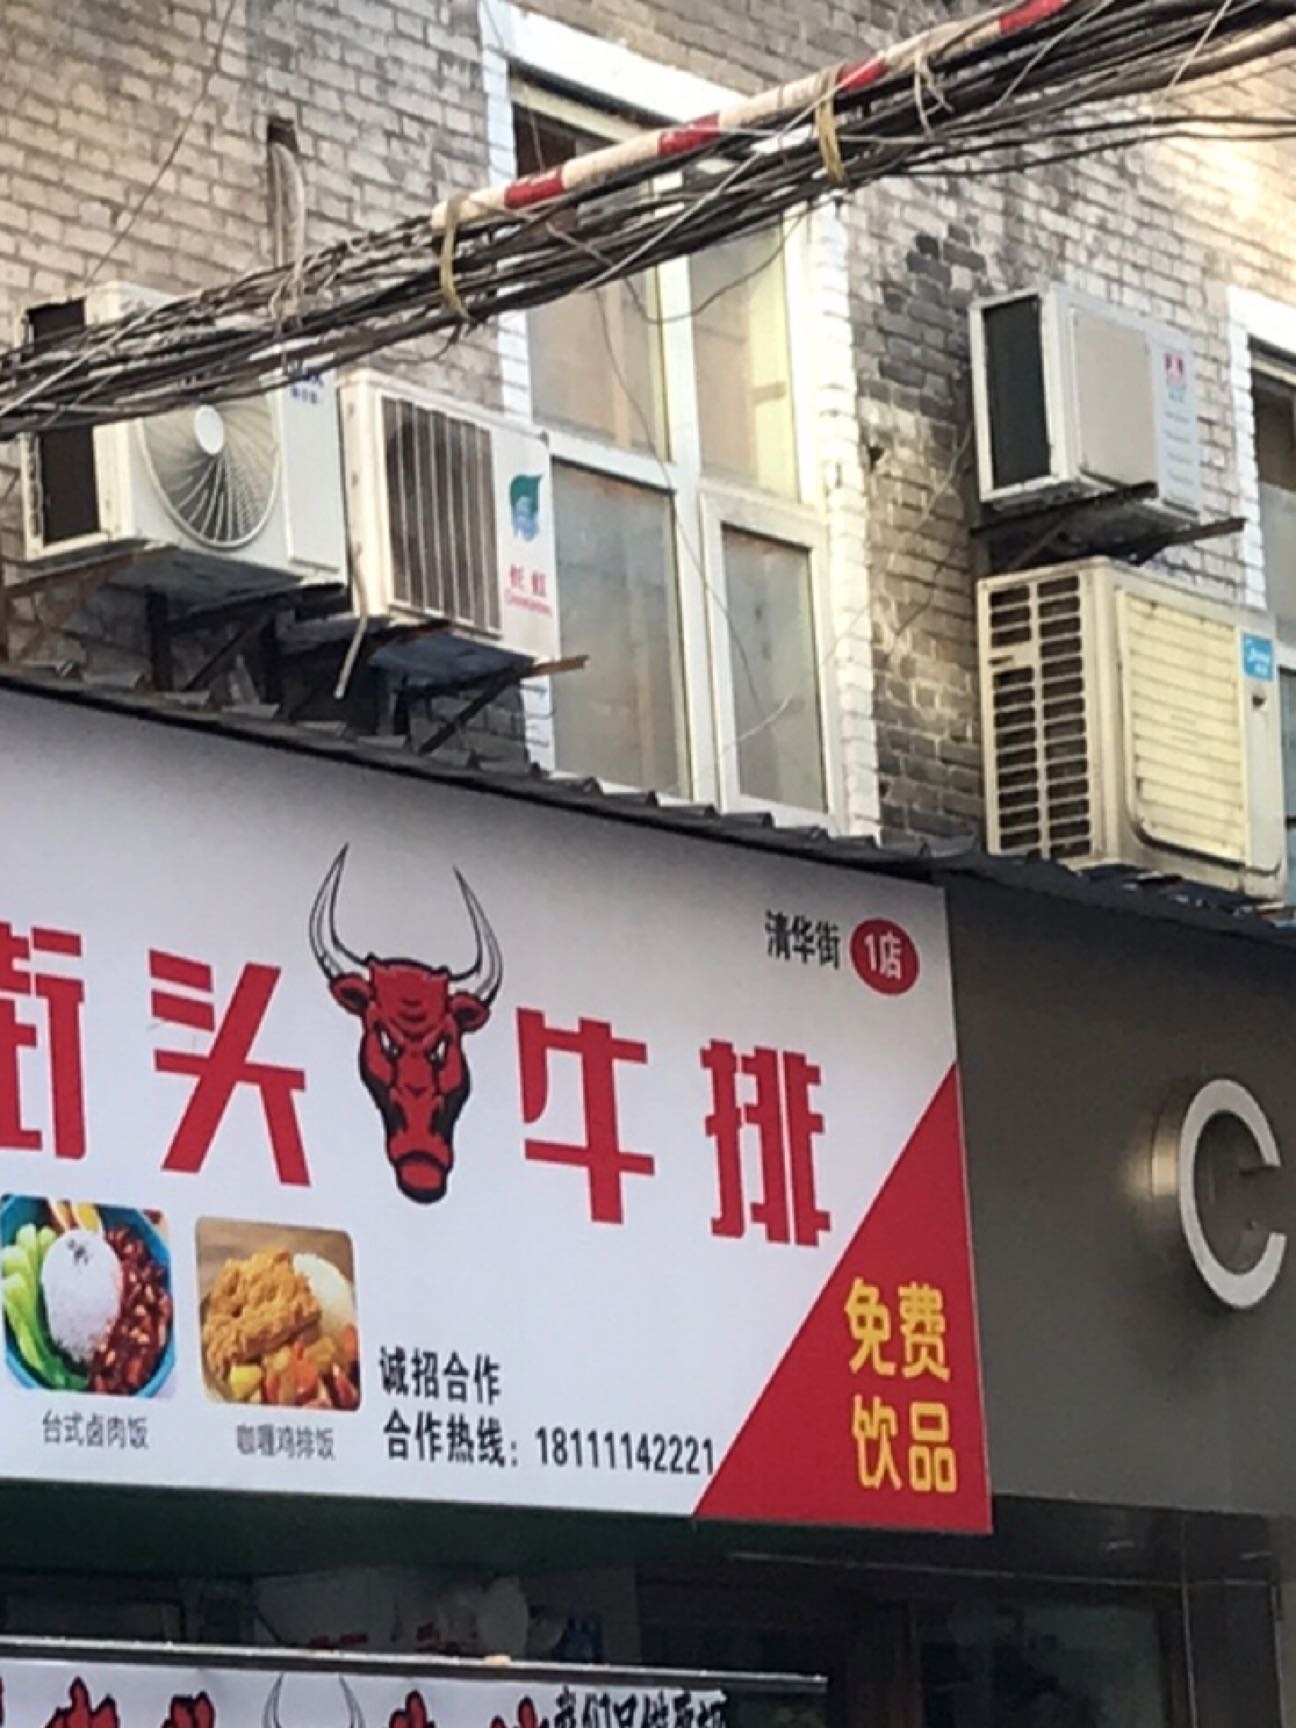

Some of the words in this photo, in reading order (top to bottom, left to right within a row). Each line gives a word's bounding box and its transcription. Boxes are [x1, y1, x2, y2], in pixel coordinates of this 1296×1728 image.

[764, 909, 841, 970] 清华街
[1178, 1078, 1287, 1309] C
[844, 1279, 951, 1382] 免费
[379, 1346, 501, 1404] 诚招合作
[42, 1409, 149, 1450] 台式卤肉饭
[236, 1424, 337, 1461] 咖喱鸡排饭
[852, 1394, 958, 1494] 饮品
